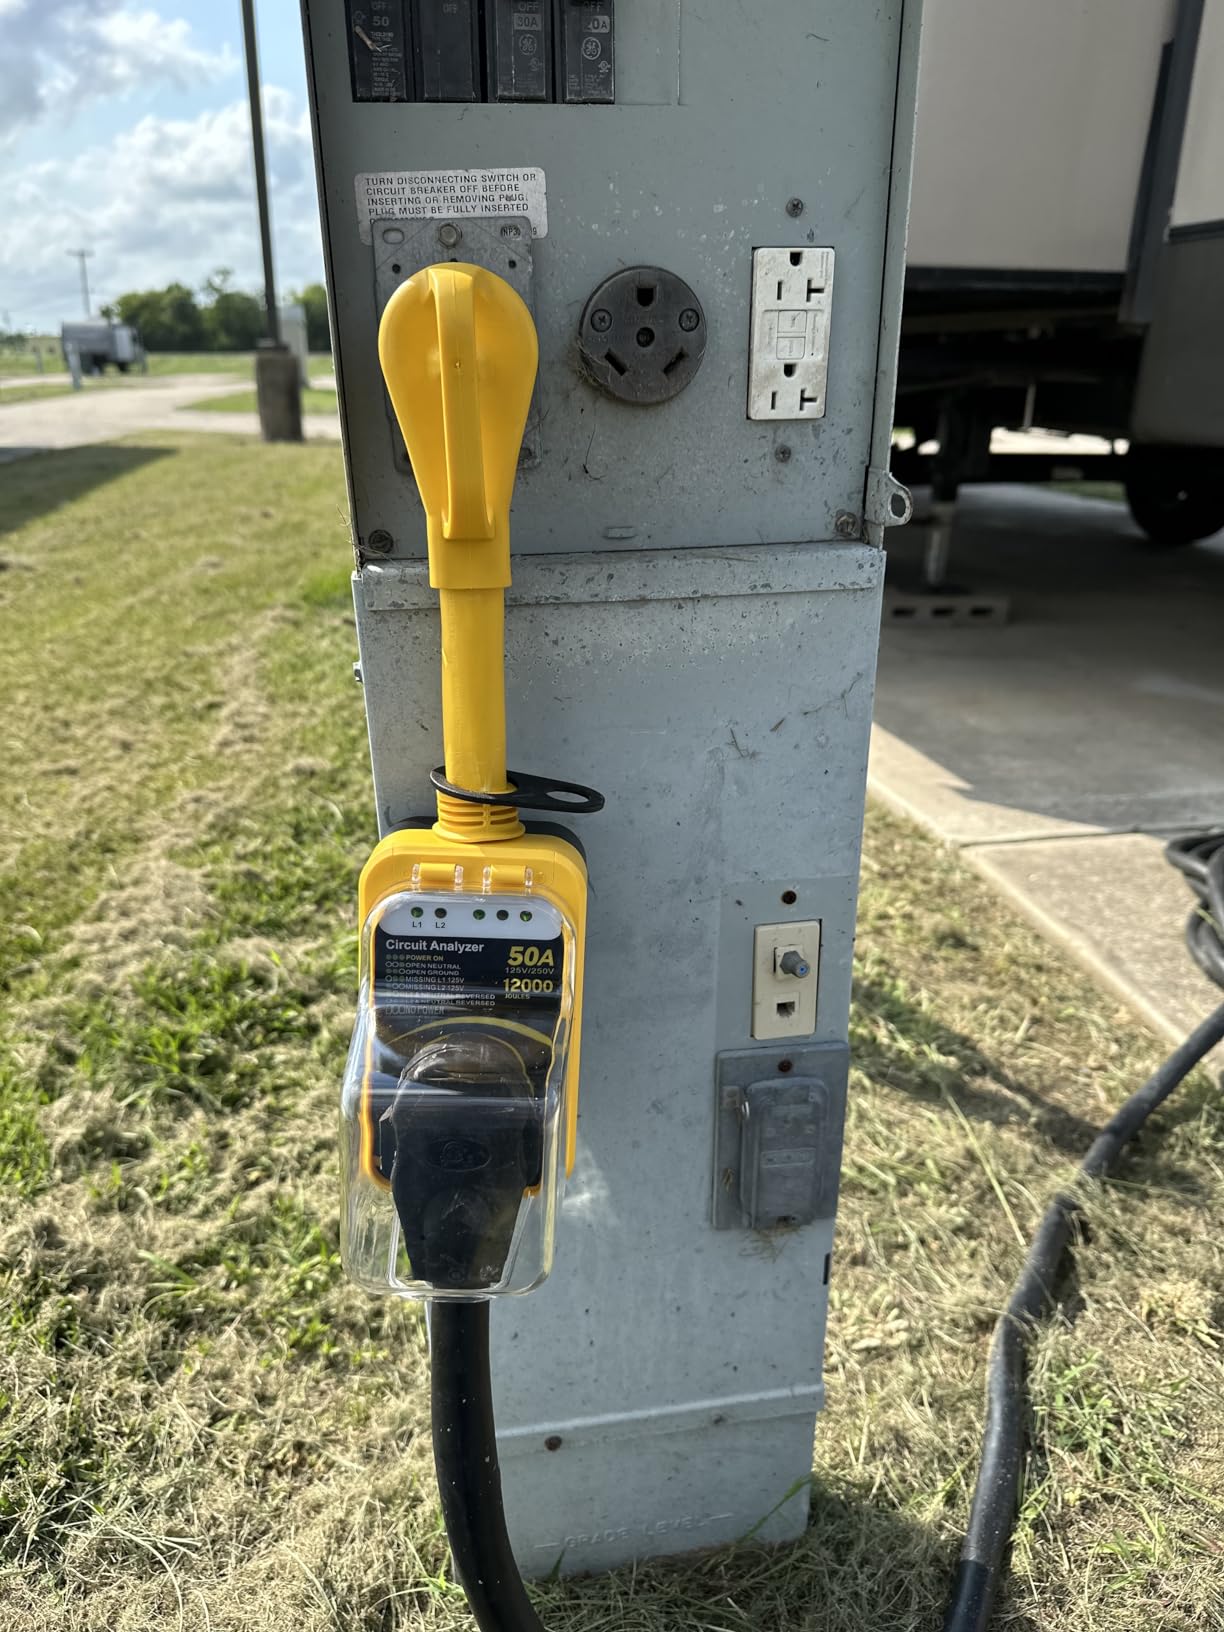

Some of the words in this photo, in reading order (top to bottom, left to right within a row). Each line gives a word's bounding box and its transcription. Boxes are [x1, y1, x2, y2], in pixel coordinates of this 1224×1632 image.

[519, 2, 539, 11] OFF
[372, 16, 390, 26] 50
[517, 16, 538, 28] 30A
[366, 177, 393, 186] TURN
[397, 175, 477, 185] DISCONNECTING
[481, 173, 519, 183] SWITCH
[522, 173, 536, 182] OR
[366, 187, 405, 196] CIRCUIT
[410, 185, 456, 194] BREAKER
[459, 184, 478, 193] OFF
[482, 183, 520, 192] BEFORE
[367, 197, 422, 206] INSERTING
[425, 196, 439, 205] OR
[444, 194, 495, 204] REMOVING
[368, 206, 395, 216] PLUG
[399, 205, 427, 215] MUST
[430, 205, 443, 214] BE
[446, 205, 477, 214] FULLY
[480, 203, 529, 213] INSERTED
[412, 920, 423, 929] L1
[435, 921, 446, 929] L2
[385, 939, 428, 951] Circuit
[429, 940, 485, 954] Analyzer
[405, 954, 431, 962] POWER
[507, 946, 554, 966] 50A
[427, 962, 461, 970] NEUTRAL
[504, 967, 554, 975] 125V/250V
[405, 968, 427, 976] OPEN
[405, 983, 436, 991] MISSING
[503, 978, 554, 993] 12000
[417, 1006, 445, 1015] POWER
